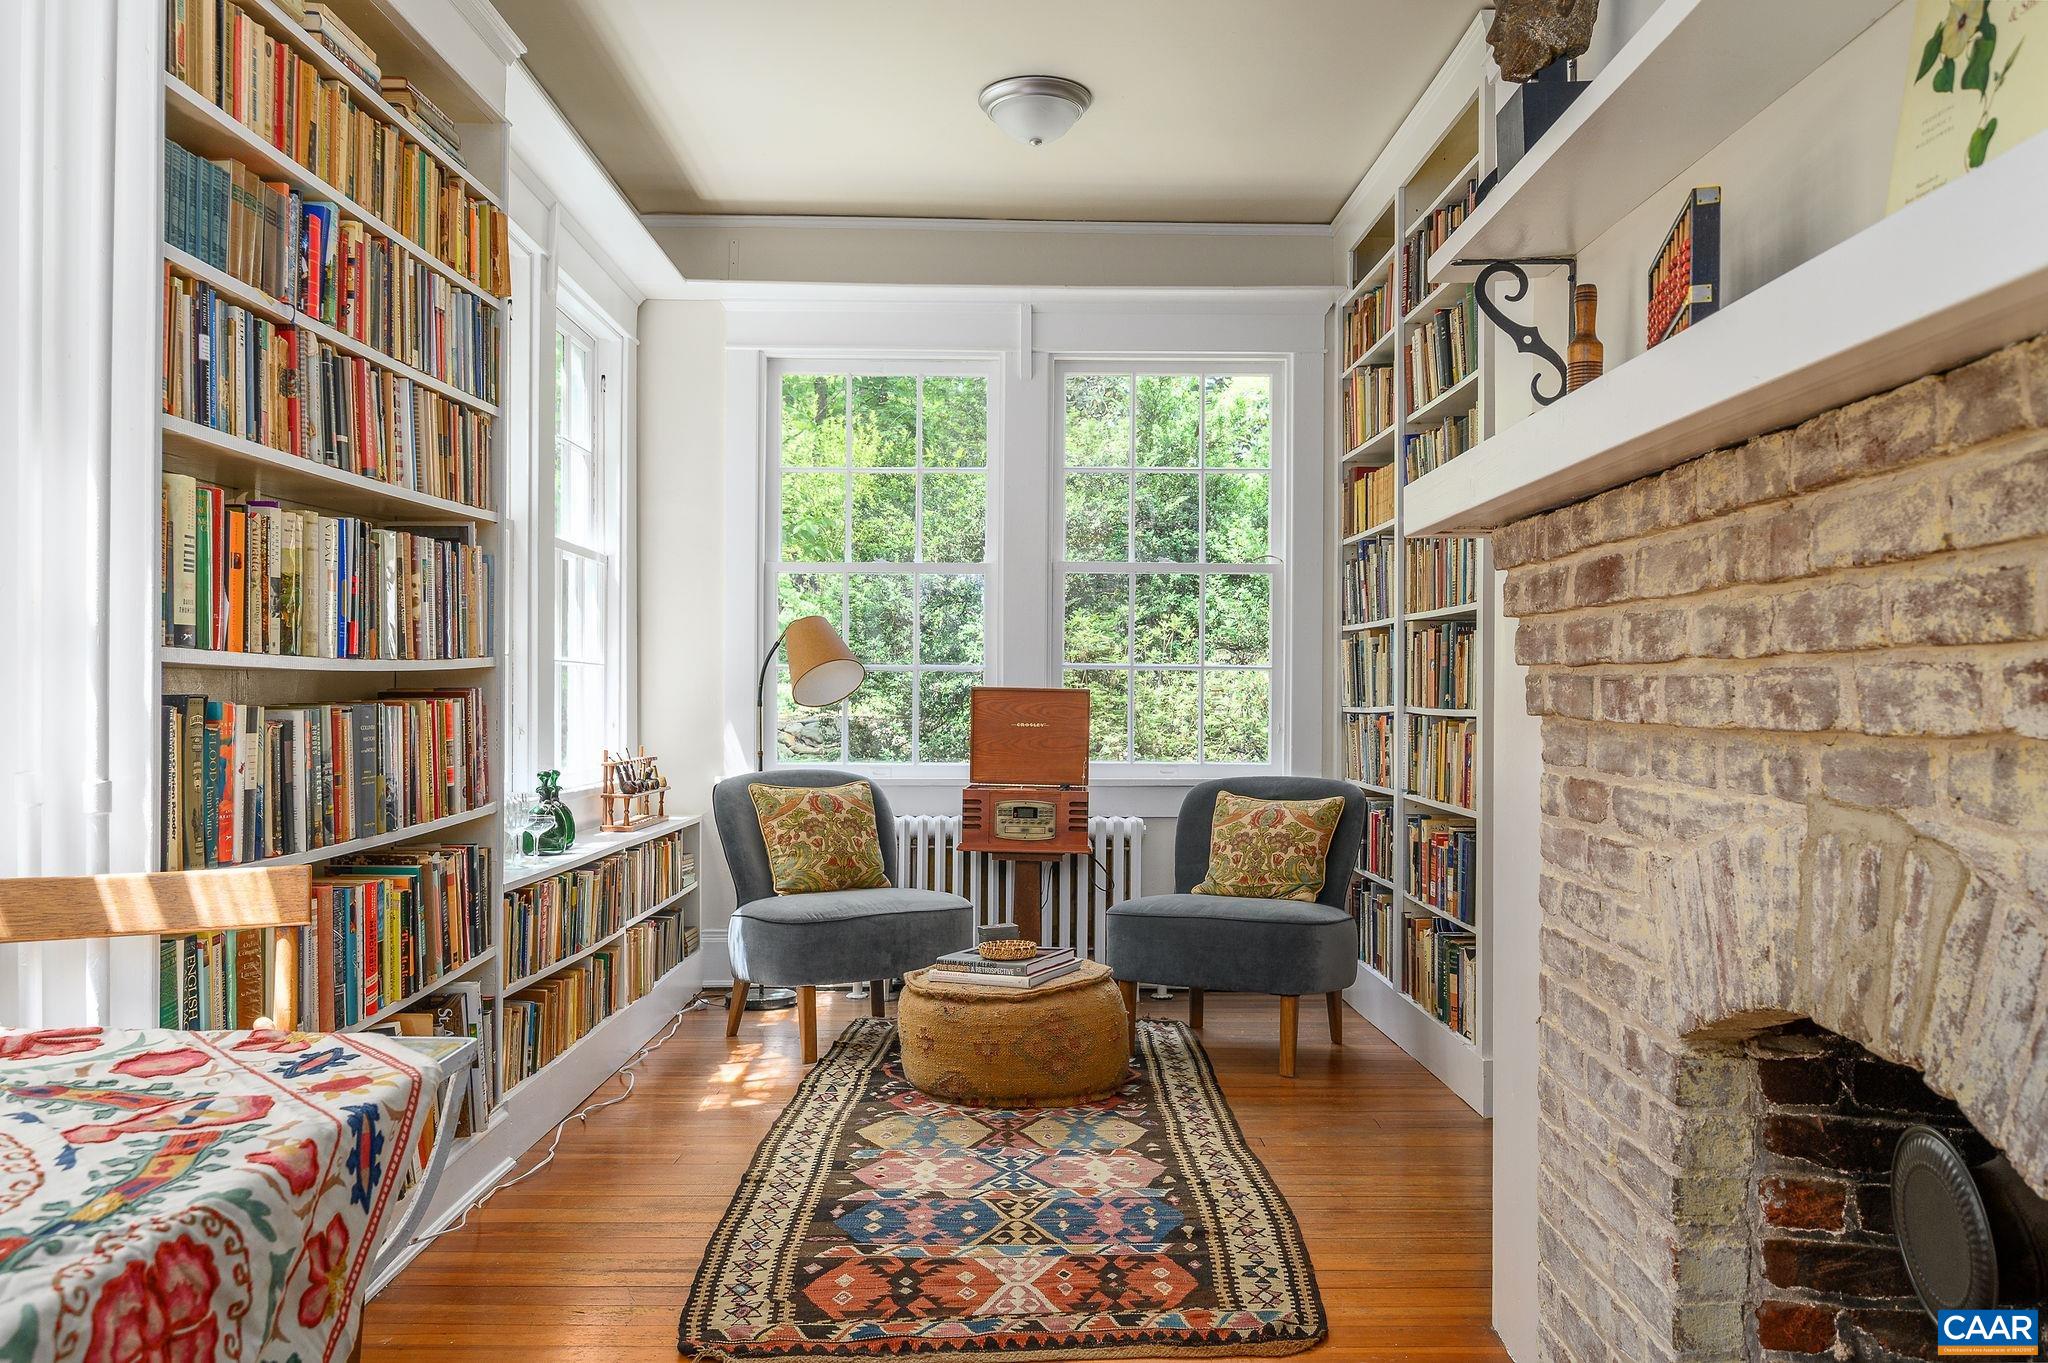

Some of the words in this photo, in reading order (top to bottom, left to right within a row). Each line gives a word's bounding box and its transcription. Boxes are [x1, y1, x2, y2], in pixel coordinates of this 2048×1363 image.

[324, 523, 332, 567] VIDAL
[208, 731, 218, 782] FLOOD
[401, 929, 409, 953] The
[187, 953, 198, 1021] ENGLISH
[975, 967, 1014, 975] RETROSPECTIVE
